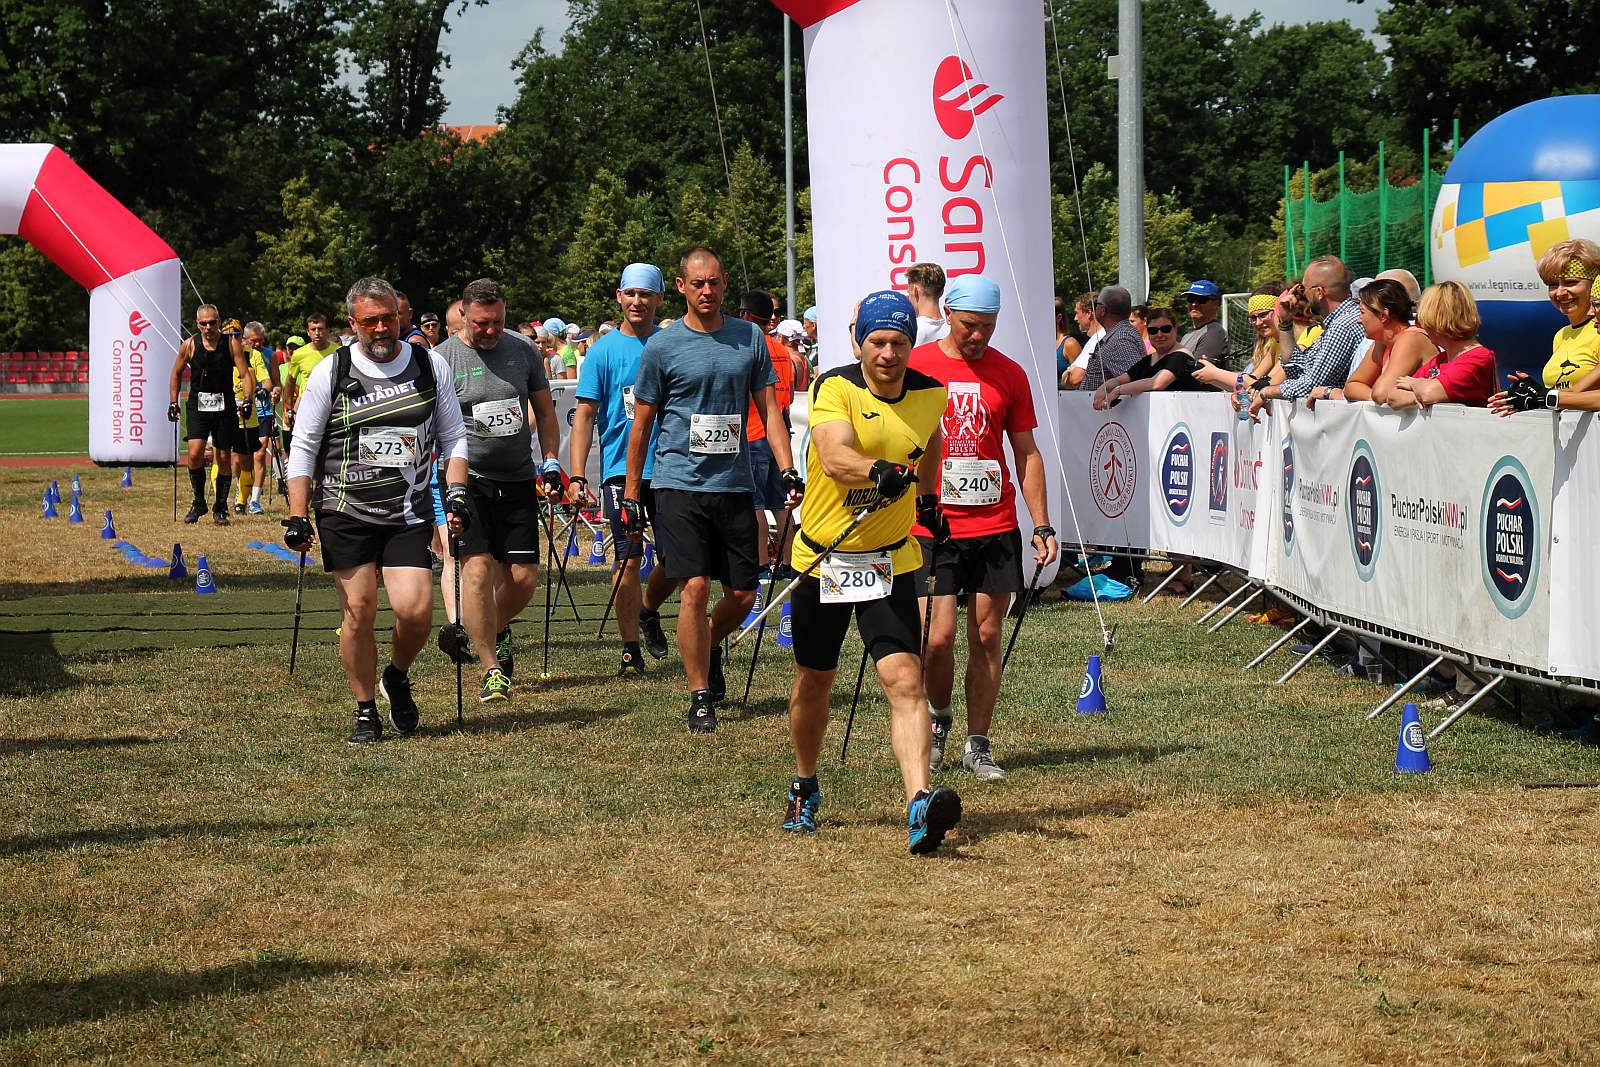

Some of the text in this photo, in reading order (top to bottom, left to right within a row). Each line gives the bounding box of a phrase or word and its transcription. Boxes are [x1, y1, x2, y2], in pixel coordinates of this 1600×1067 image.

[1468, 279, 1540, 293] www.legnica.eu
[112, 339, 125, 444] Consumer Bank
[129, 340, 148, 446] Santander
[487, 413, 513, 427] 255
[704, 429, 730, 443] 229
[374, 441, 403, 456] 273
[958, 477, 989, 492] 240
[1169, 470, 1189, 486] POLSKI
[1391, 493, 1469, 536] PucharPolskiNW.pl
[1496, 512, 1523, 533] PUCHAR
[1495, 531, 1524, 556] POLSKI
[839, 570, 876, 588] 280
